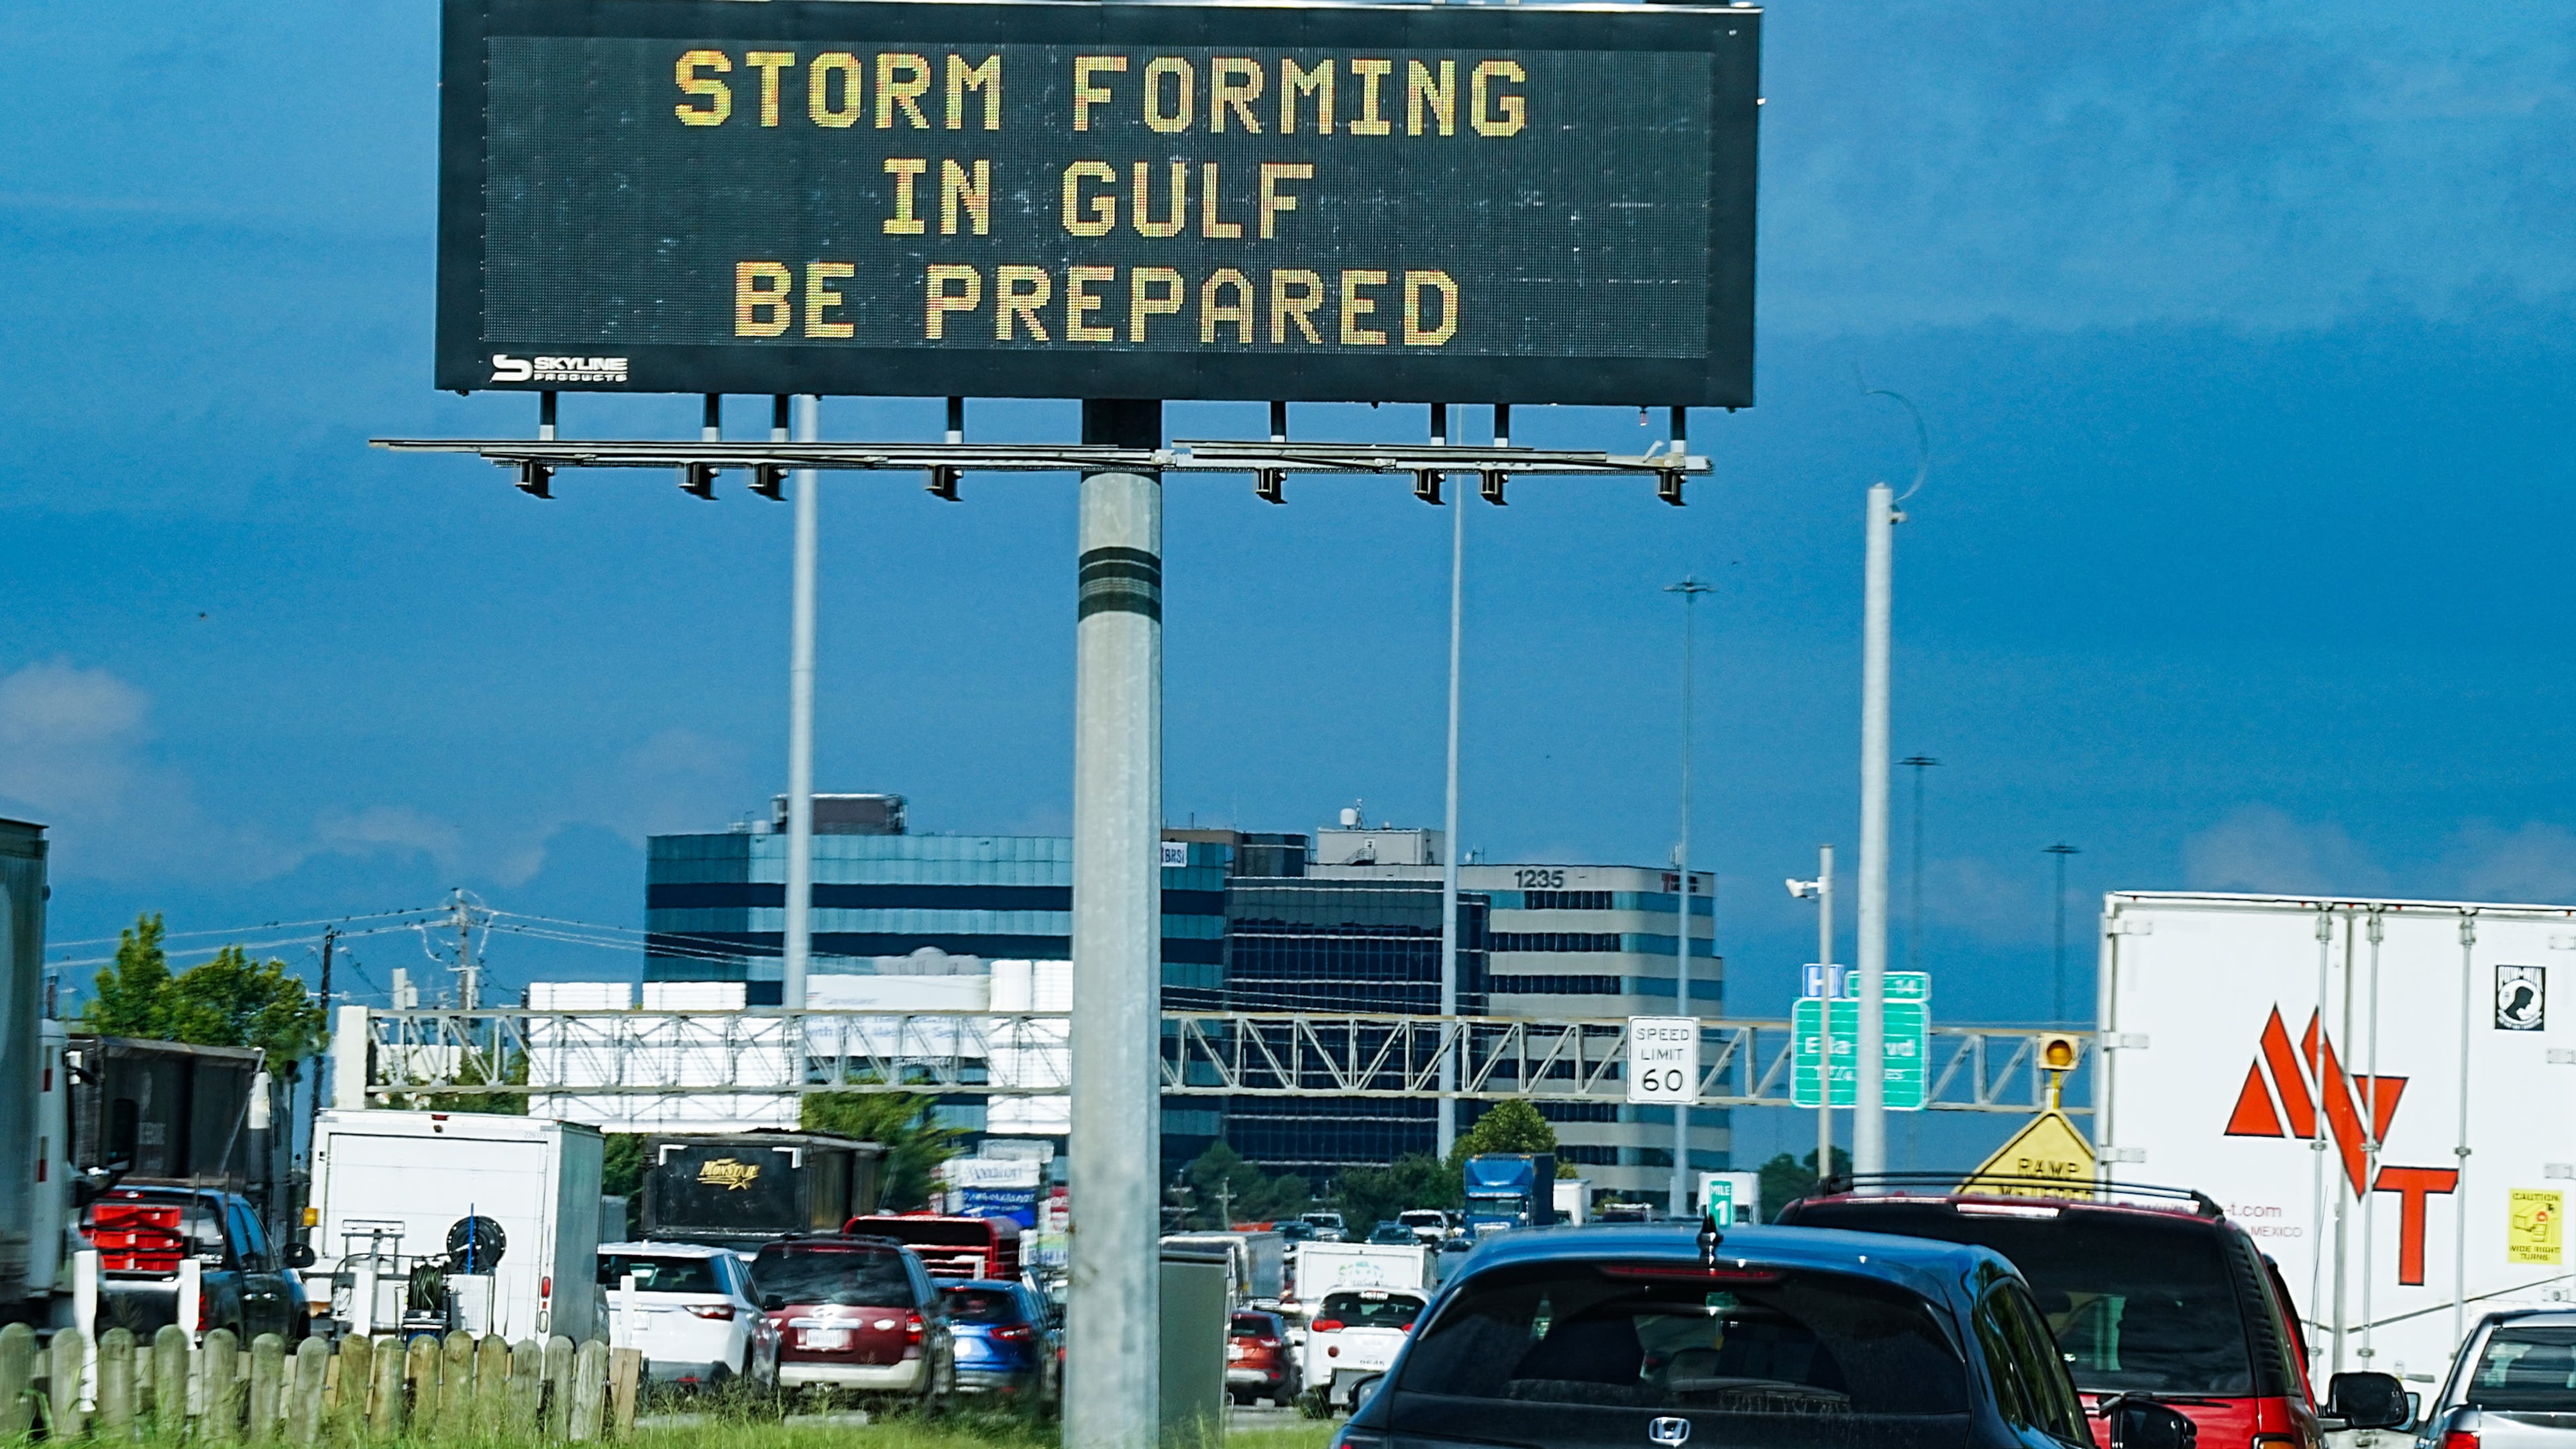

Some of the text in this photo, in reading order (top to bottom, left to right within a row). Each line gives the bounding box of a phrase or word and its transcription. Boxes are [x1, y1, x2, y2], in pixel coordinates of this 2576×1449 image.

[676, 50, 1526, 137] STORM FORMING
[883, 158, 1313, 239] IN GULF
[735, 261, 1459, 347] BE PREPARED
[534, 356, 628, 371] SKYLINE
[533, 373, 628, 382] PRODUCTS
[1514, 869, 1564, 889] 1235
[1635, 1028, 1690, 1041] SPEED
[1640, 1049, 1684, 1061] LIMIT
[1642, 1069, 1683, 1091] 60
[2018, 1158, 2080, 1179] RAMP
[1711, 1185, 1731, 1195] MILE
[2512, 1193, 2561, 1201] CAUTION
[1715, 1200, 1728, 1225] 1
[2251, 1226, 2303, 1238] MEXICO
[2510, 1245, 2532, 1253] WIDE
[2520, 1252, 2549, 1261] TURNS
